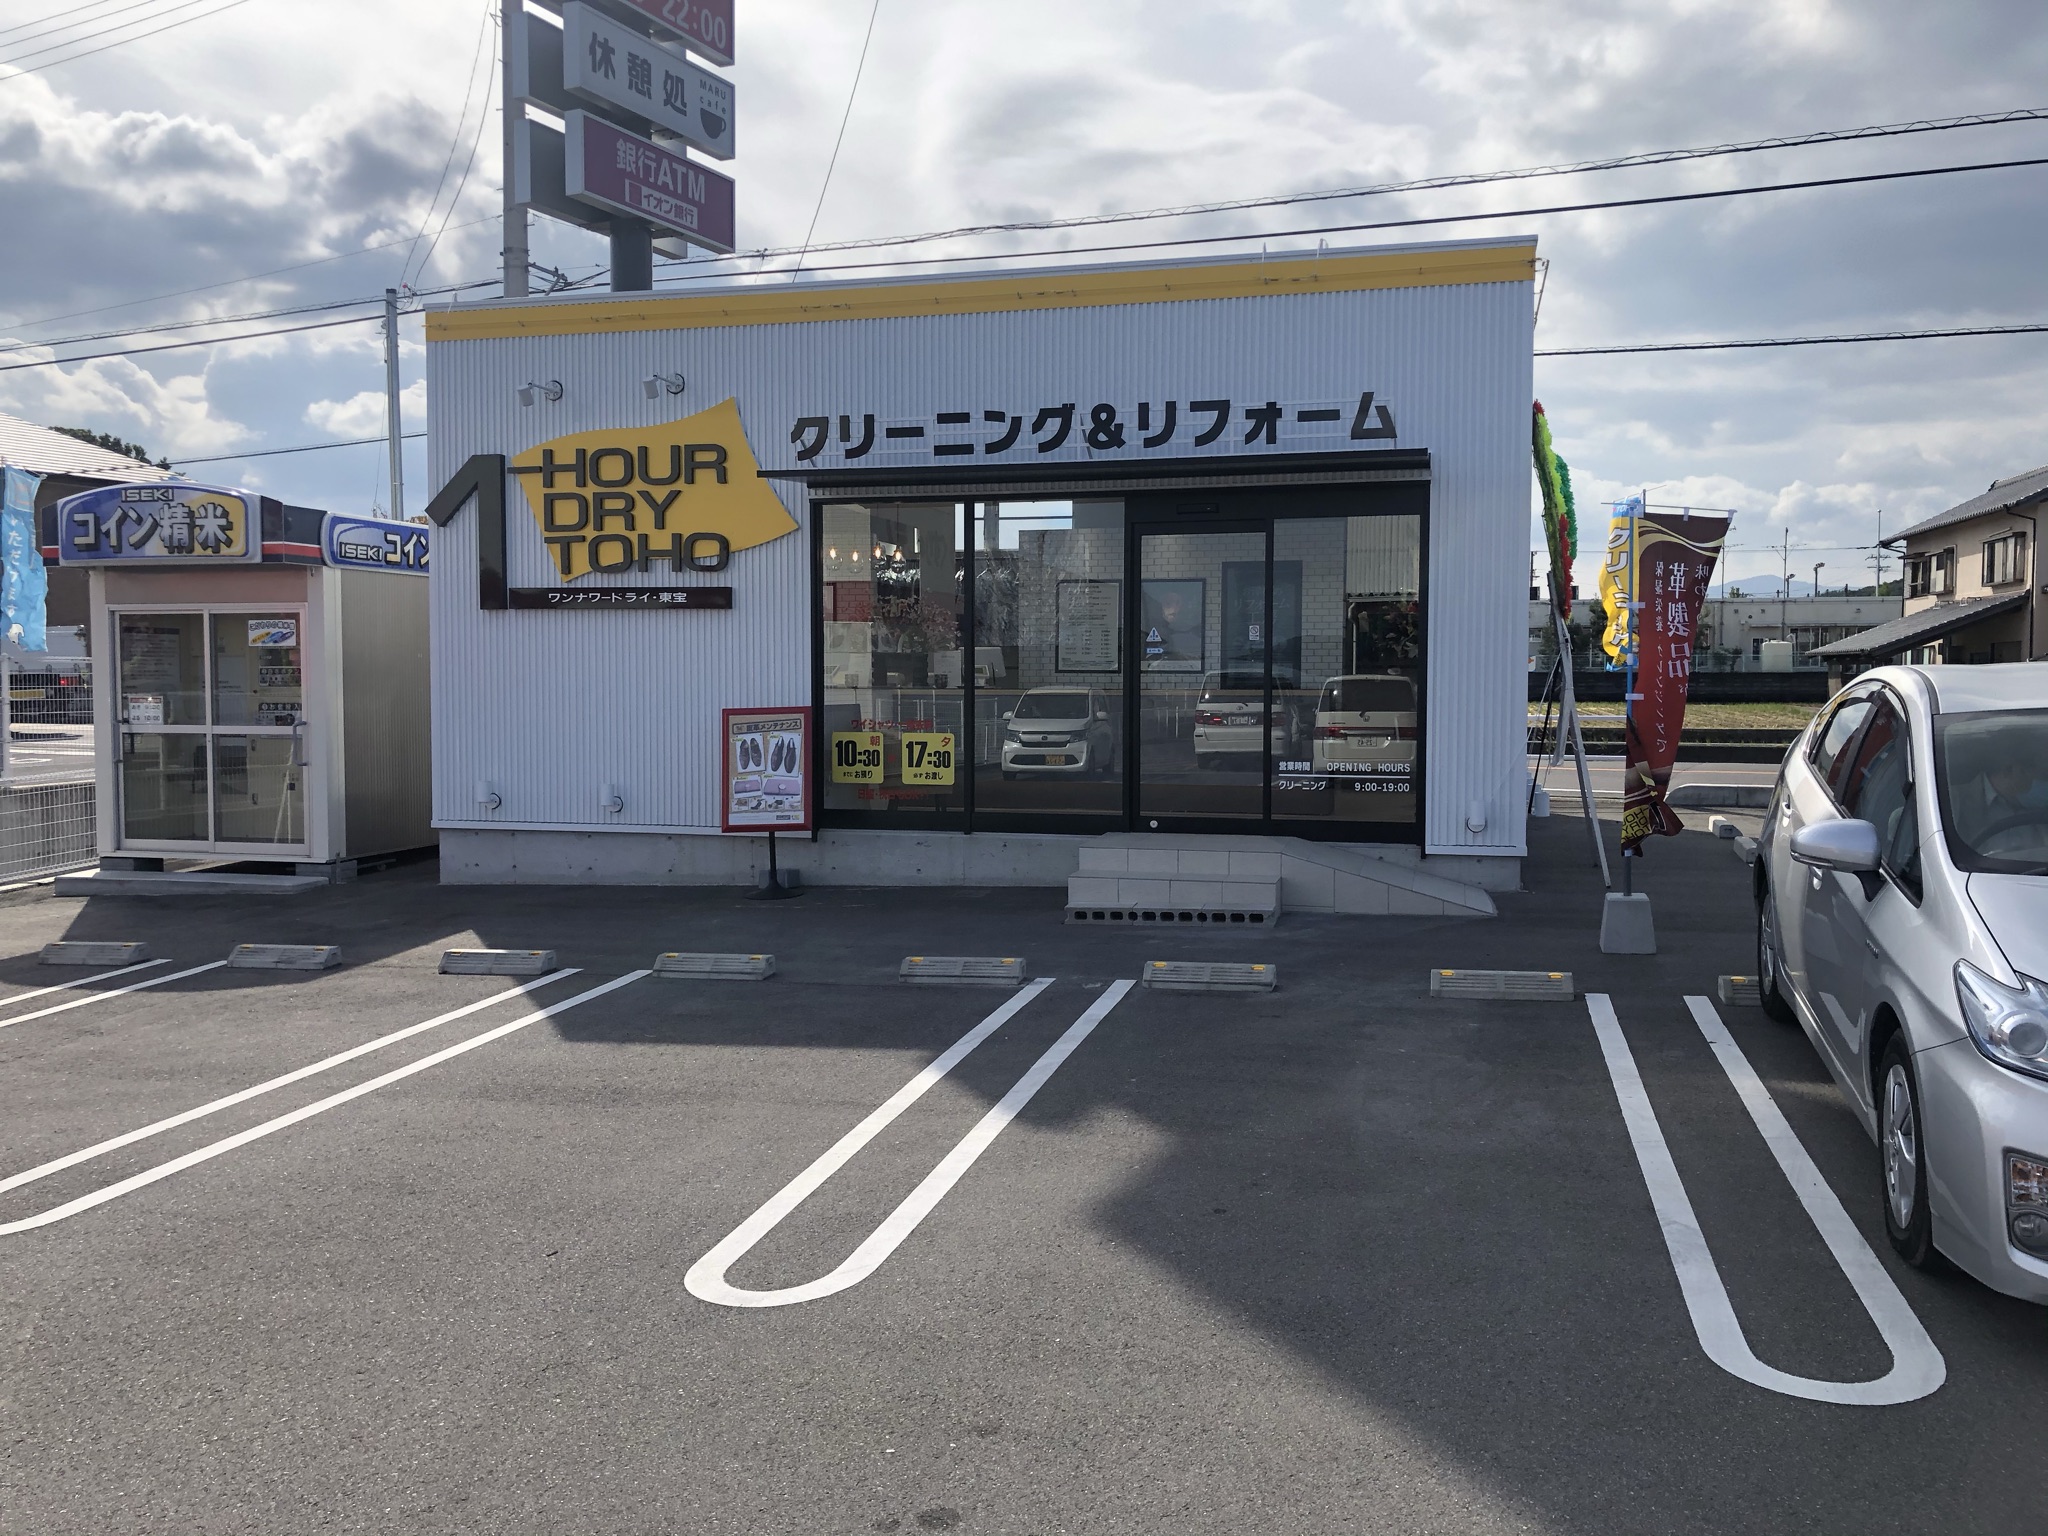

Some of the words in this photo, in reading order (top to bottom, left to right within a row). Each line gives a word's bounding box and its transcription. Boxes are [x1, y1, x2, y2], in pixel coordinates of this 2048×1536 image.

[589, 32, 687, 117] 休憩処
[700, 79, 726, 100] MARU
[700, 96, 727, 114] cafe
[616, 138, 705, 204] 銀行ATM
[642, 193, 695, 225] イオン銀行
[791, 392, 1398, 461] クリーニング&リフォーム
[121, 488, 175, 502] ISEKI
[543, 489, 682, 532] DRY
[73, 502, 234, 554] コイン精米
[339, 542, 383, 562] ISEKI
[543, 532, 731, 576] TOHO
[548, 591, 688, 604] ワンナワードライ・東宝
[869, 735, 881, 747] 朝
[941, 736, 952, 748] 夕
[835, 740, 881, 768] 10:30
[905, 741, 952, 769] 17:30
[1279, 761, 1311, 771] 営業時間
[1326, 762, 1372, 772] OPENING
[1378, 763, 1411, 773] HOURS
[1278, 780, 1327, 791] クリーニング
[1354, 782, 1410, 792] 9:00-19:00
